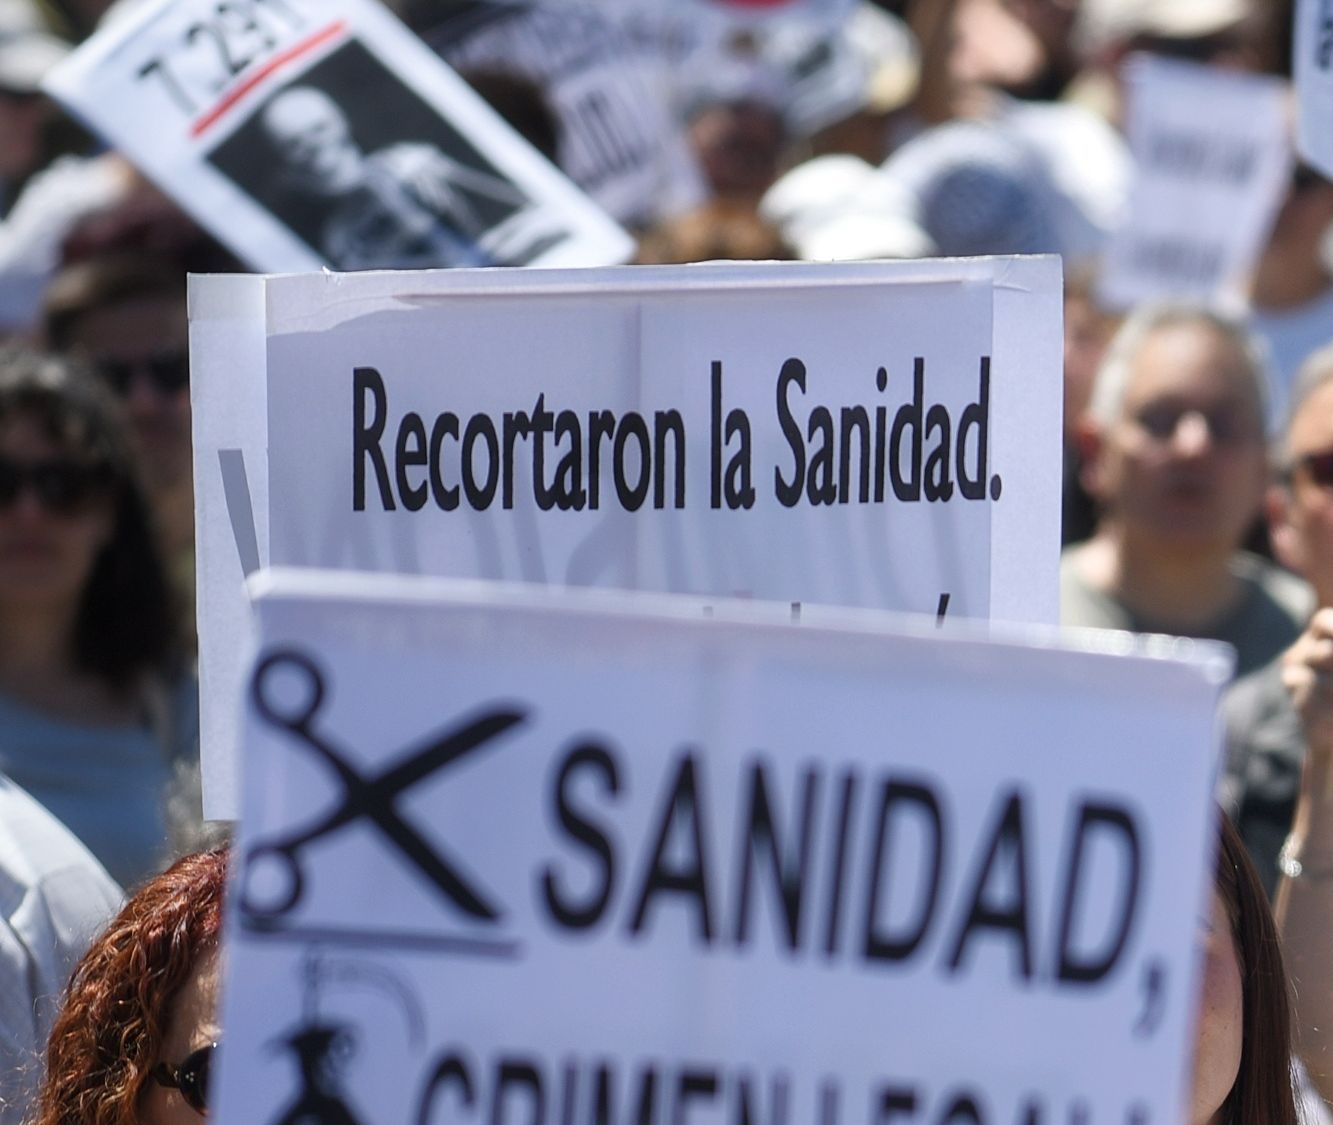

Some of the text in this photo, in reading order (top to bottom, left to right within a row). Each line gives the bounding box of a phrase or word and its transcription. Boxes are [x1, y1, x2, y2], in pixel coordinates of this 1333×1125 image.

[353, 366, 686, 512] Recortaron
[711, 360, 756, 510] la
[775, 355, 1003, 507] Sanidad.
[540, 735, 1168, 1038] SANIDAD,
